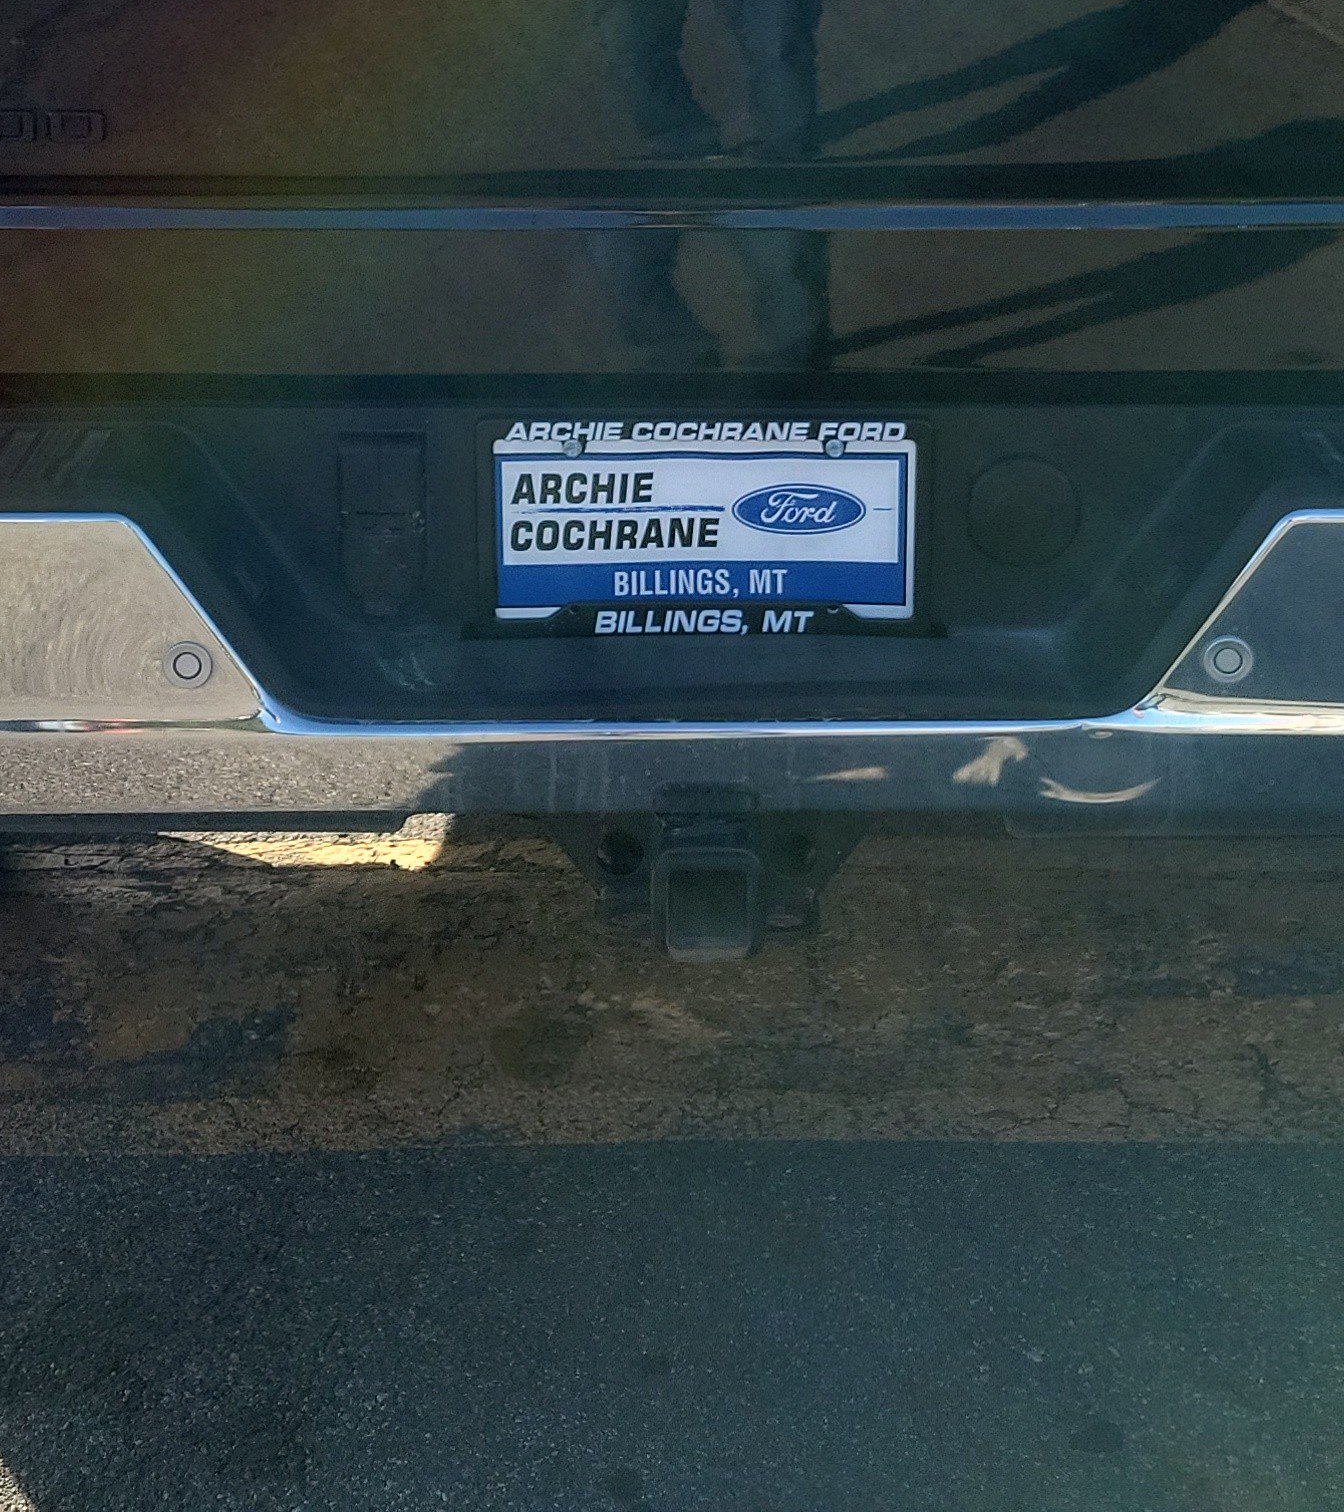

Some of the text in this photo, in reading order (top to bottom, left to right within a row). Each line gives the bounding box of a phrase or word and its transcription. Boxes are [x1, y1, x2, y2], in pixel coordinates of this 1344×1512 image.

[505, 422, 907, 442] ARCHIE COCHRANE FORD
[510, 471, 654, 505] ARCHIE
[759, 493, 837, 525] Ford
[510, 518, 720, 552] COCHRANE
[613, 568, 788, 598] BILLINGS, MT
[594, 609, 814, 636] BILLINGS, MT
